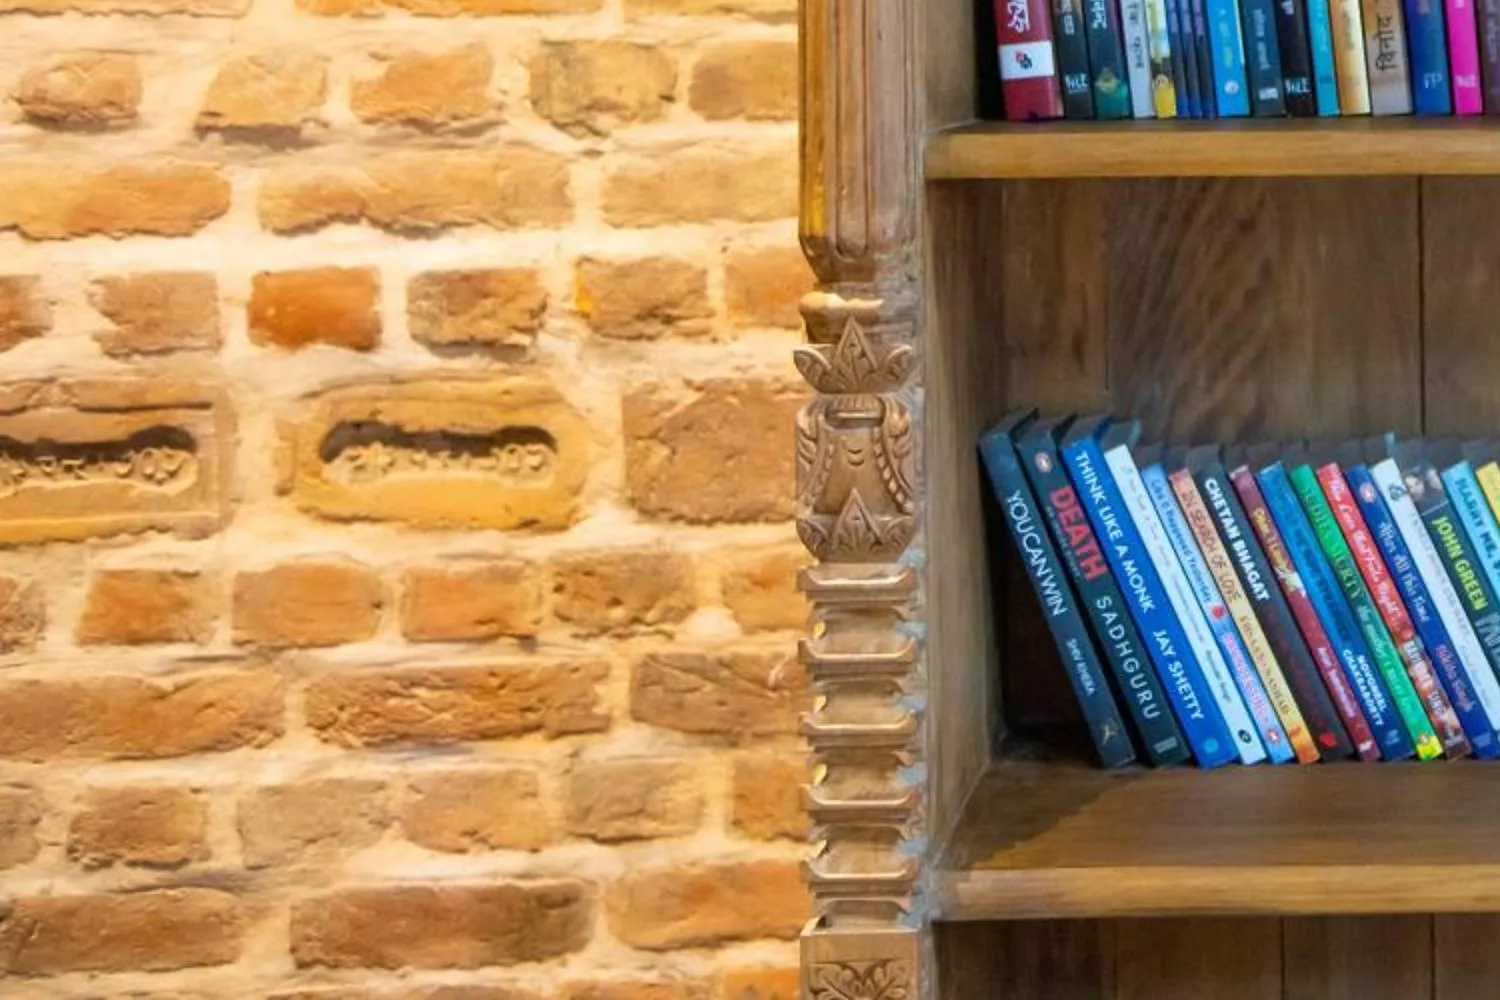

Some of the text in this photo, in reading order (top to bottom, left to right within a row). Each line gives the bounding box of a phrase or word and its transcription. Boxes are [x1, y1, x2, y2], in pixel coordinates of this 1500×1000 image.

[1047, 483, 1108, 581] DEATH
[1073, 451, 1156, 614] THINK LIKE A MONK
[1188, 508, 1219, 554] SEARCH
[1201, 476, 1242, 540] CHETAN
[1229, 538, 1271, 603] BHAGAT
[1209, 553, 1227, 572] OF
[1431, 513, 1464, 559] JOHN
[1452, 557, 1489, 612] GREEN
[1453, 476, 1486, 528] MARRY
[1477, 530, 1500, 559] ME,
[1217, 571, 1241, 604] LOVE
[1092, 594, 1162, 721] SADHGURU
[1151, 627, 1205, 723] JAY SHETTY
